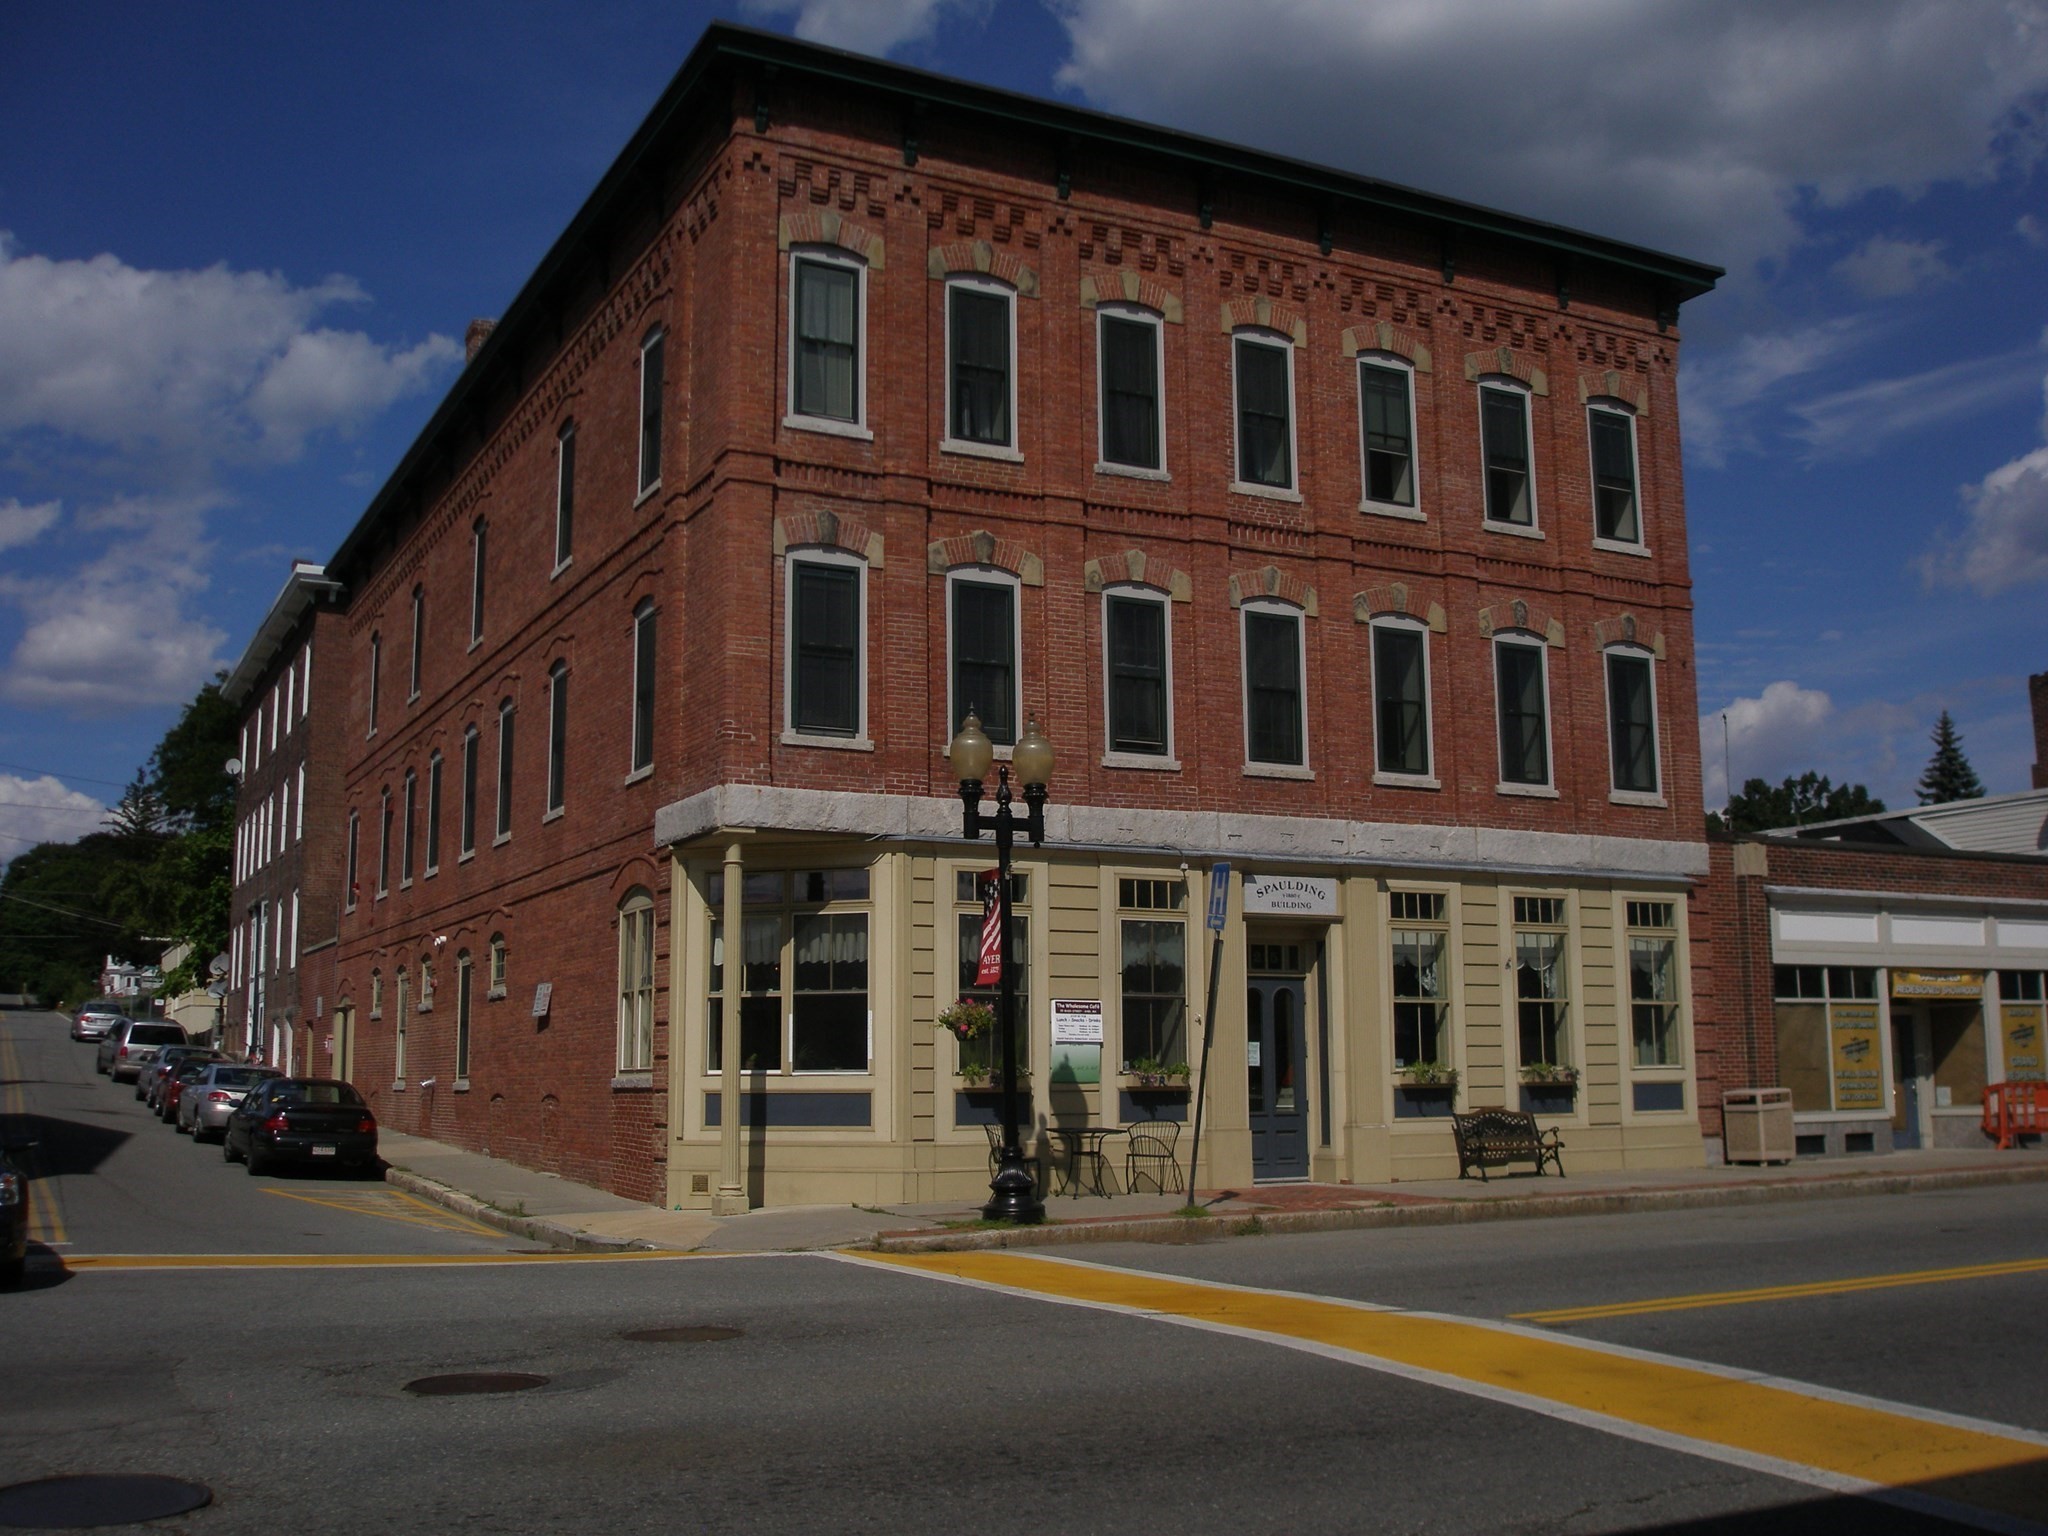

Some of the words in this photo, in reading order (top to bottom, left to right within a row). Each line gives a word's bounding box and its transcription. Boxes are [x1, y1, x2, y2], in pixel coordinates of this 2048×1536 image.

[1212, 872, 1226, 914] H
[1256, 880, 1326, 900] SPAULDING
[1271, 901, 1312, 909] BUILDING
[982, 954, 1000, 965] AYER
